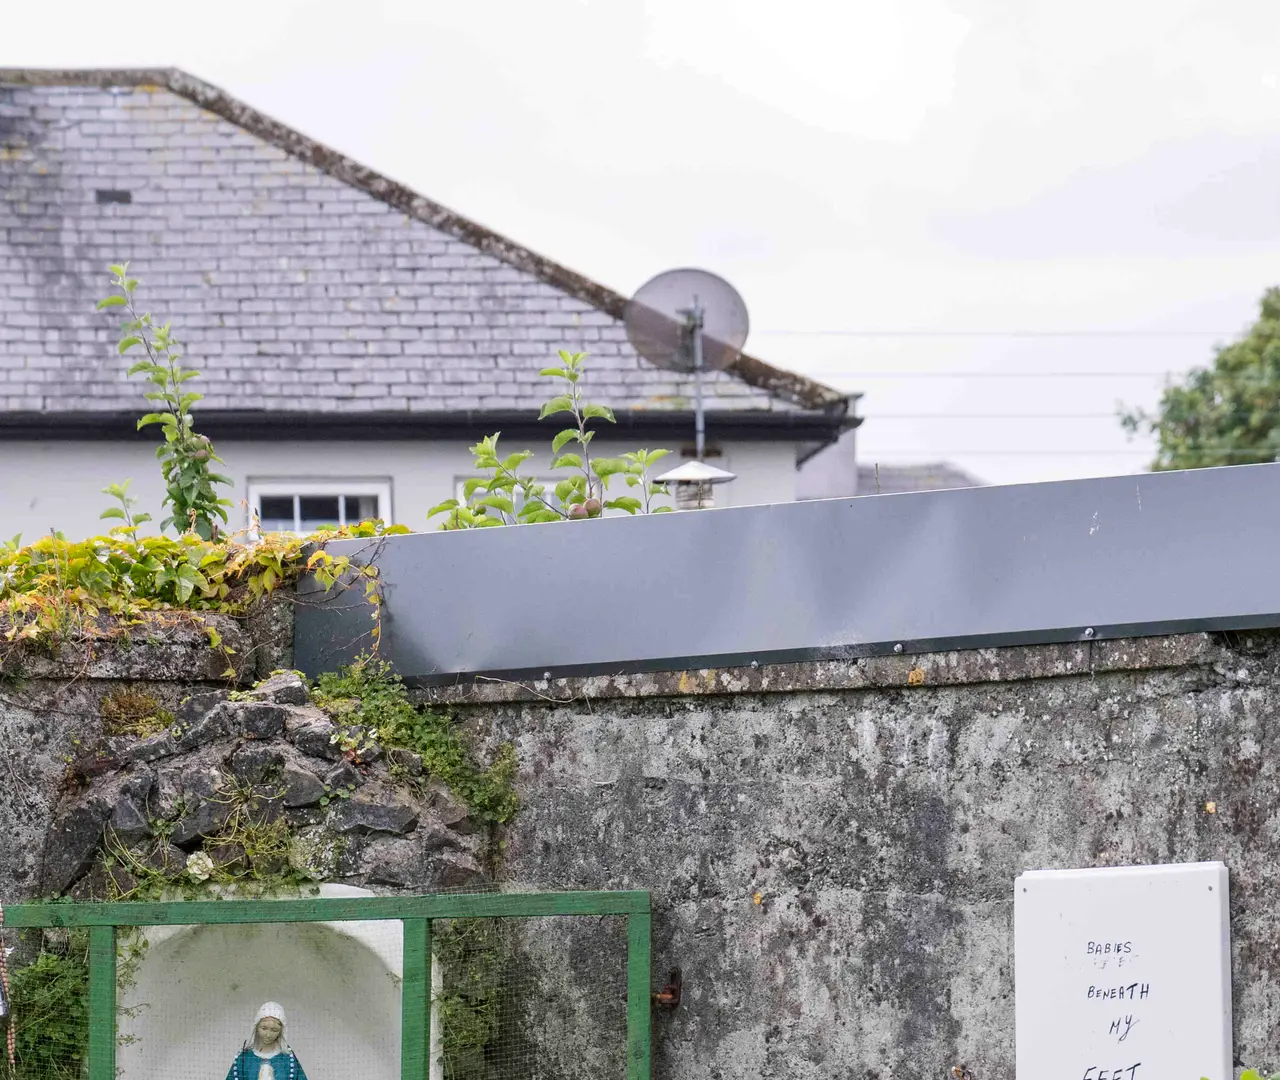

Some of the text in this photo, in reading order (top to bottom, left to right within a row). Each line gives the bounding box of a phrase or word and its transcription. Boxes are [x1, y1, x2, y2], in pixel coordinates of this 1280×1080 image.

[1086, 940, 1132, 955] BABIES
[1087, 982, 1150, 1000] BENEATH
[1108, 1013, 1141, 1045] MY
